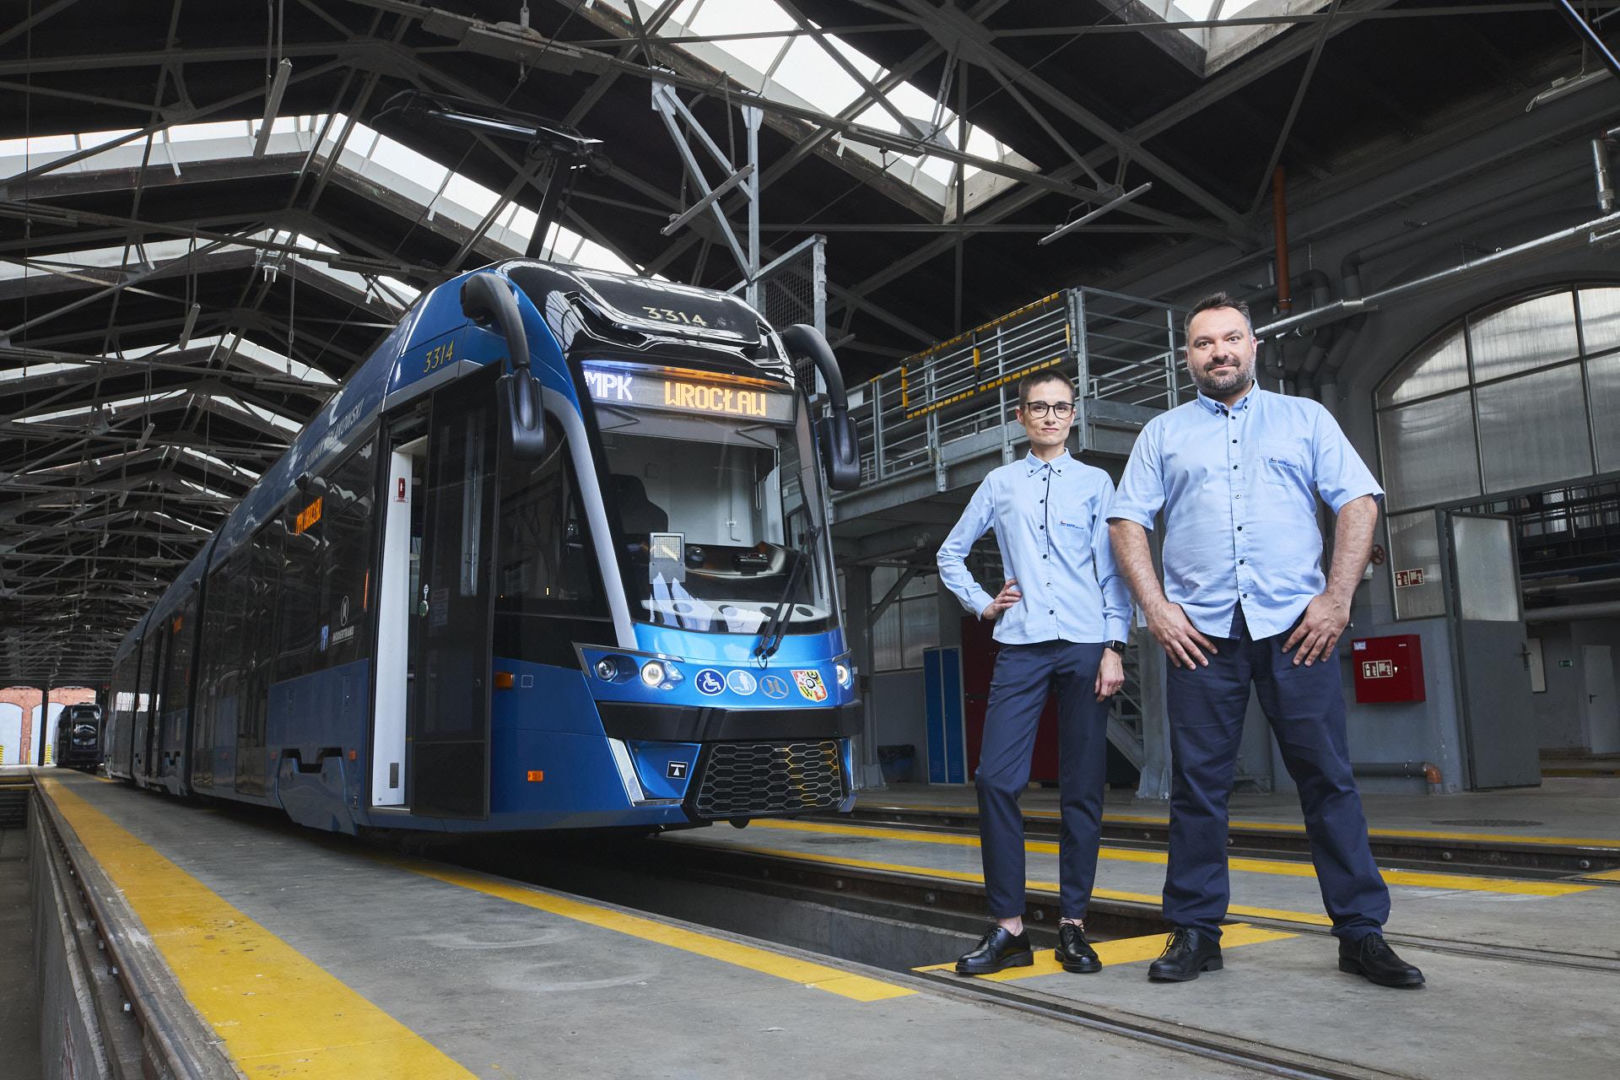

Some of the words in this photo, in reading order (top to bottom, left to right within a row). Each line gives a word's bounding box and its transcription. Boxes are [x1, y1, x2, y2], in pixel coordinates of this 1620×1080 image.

[642, 306, 707, 327] 3314
[424, 340, 454, 373] 3314
[583, 371, 632, 400] MPK
[665, 381, 766, 416] WROCŁAW
